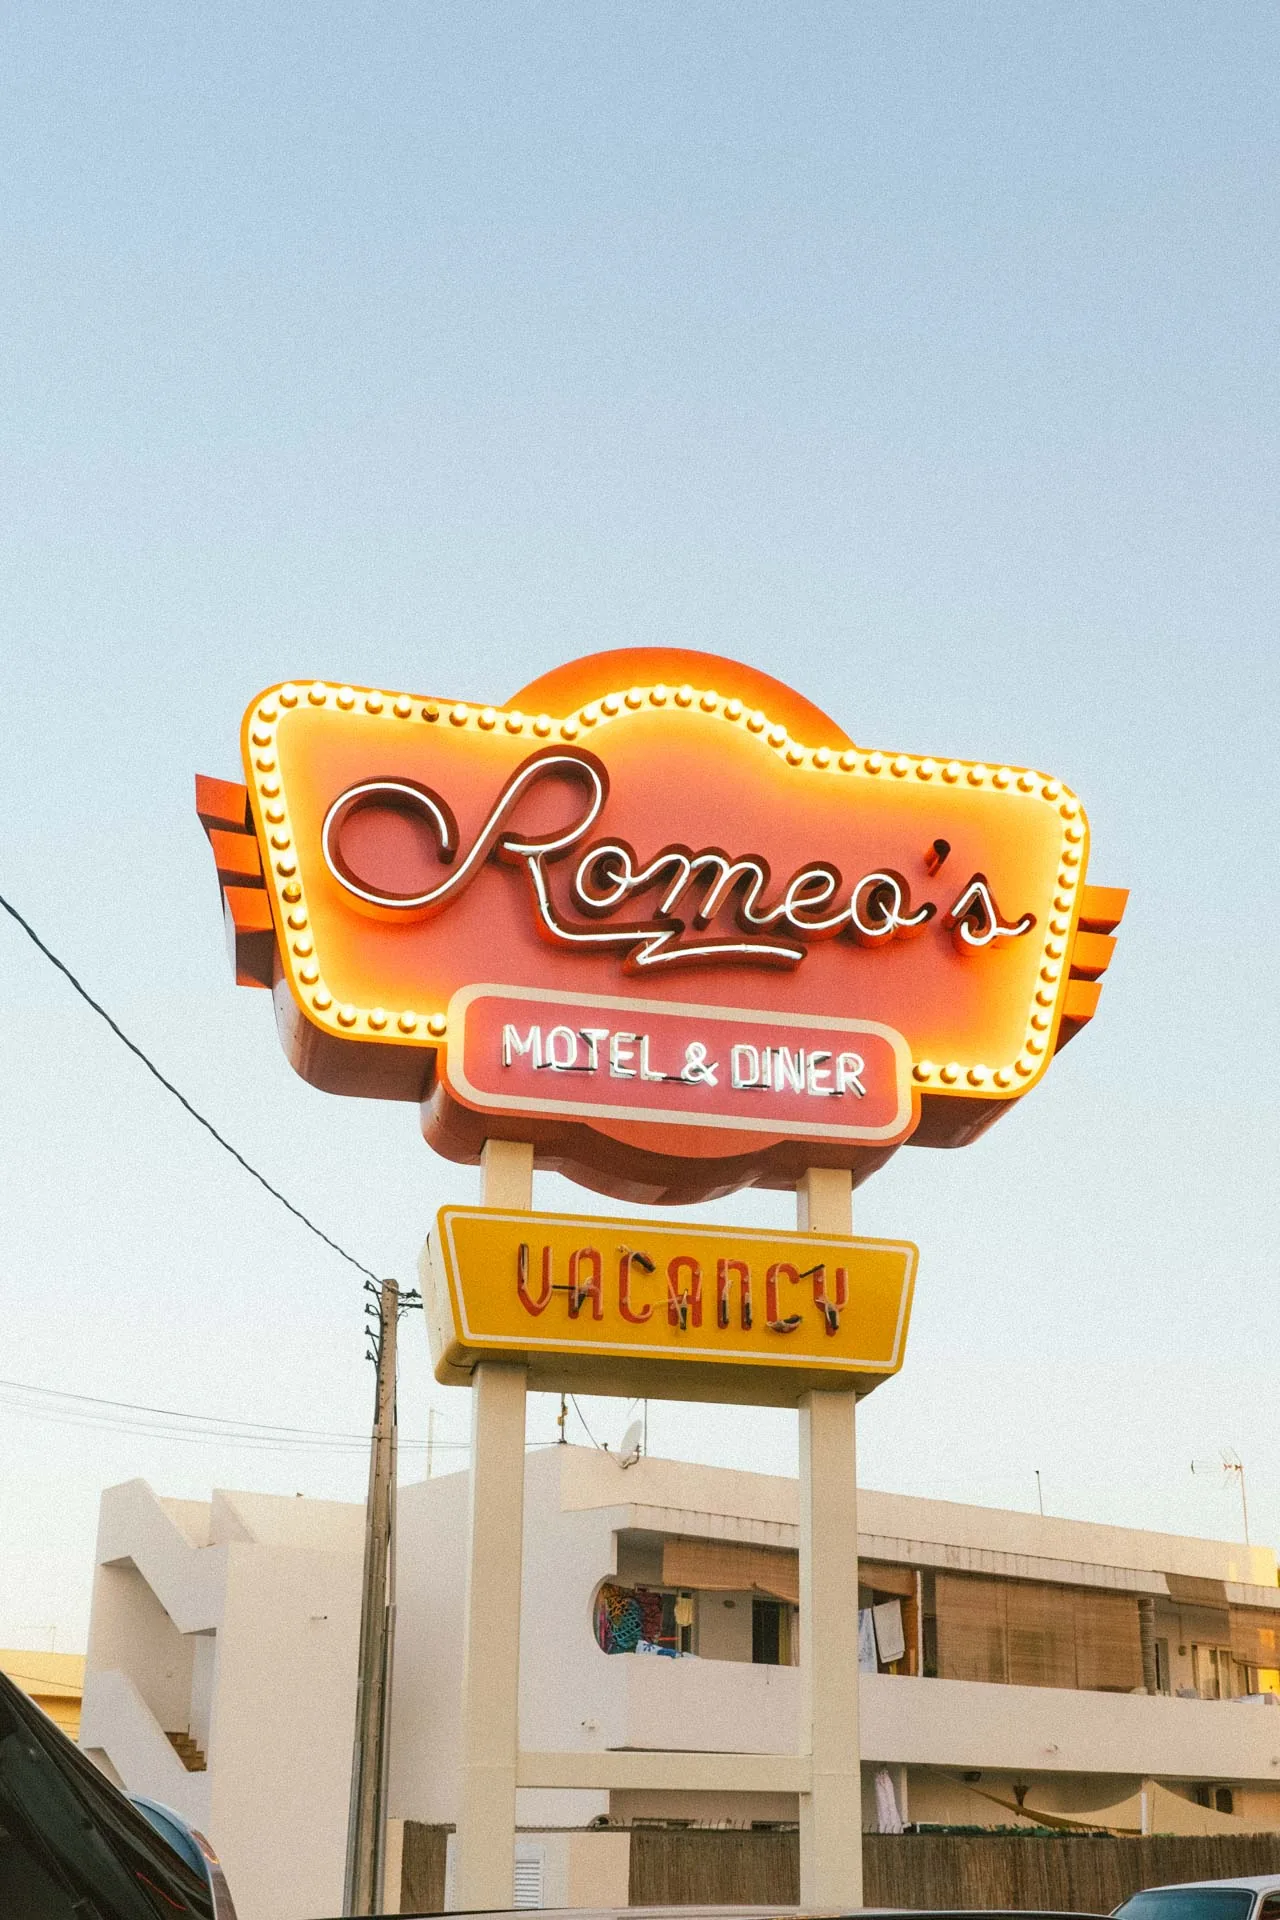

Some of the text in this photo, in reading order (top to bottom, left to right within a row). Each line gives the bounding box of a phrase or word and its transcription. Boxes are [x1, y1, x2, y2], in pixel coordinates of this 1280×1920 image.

[321, 746, 1036, 974] Romeo's
[502, 1022, 867, 1099] MOTEL & DINER
[517, 1242, 850, 1336] VACANCY
